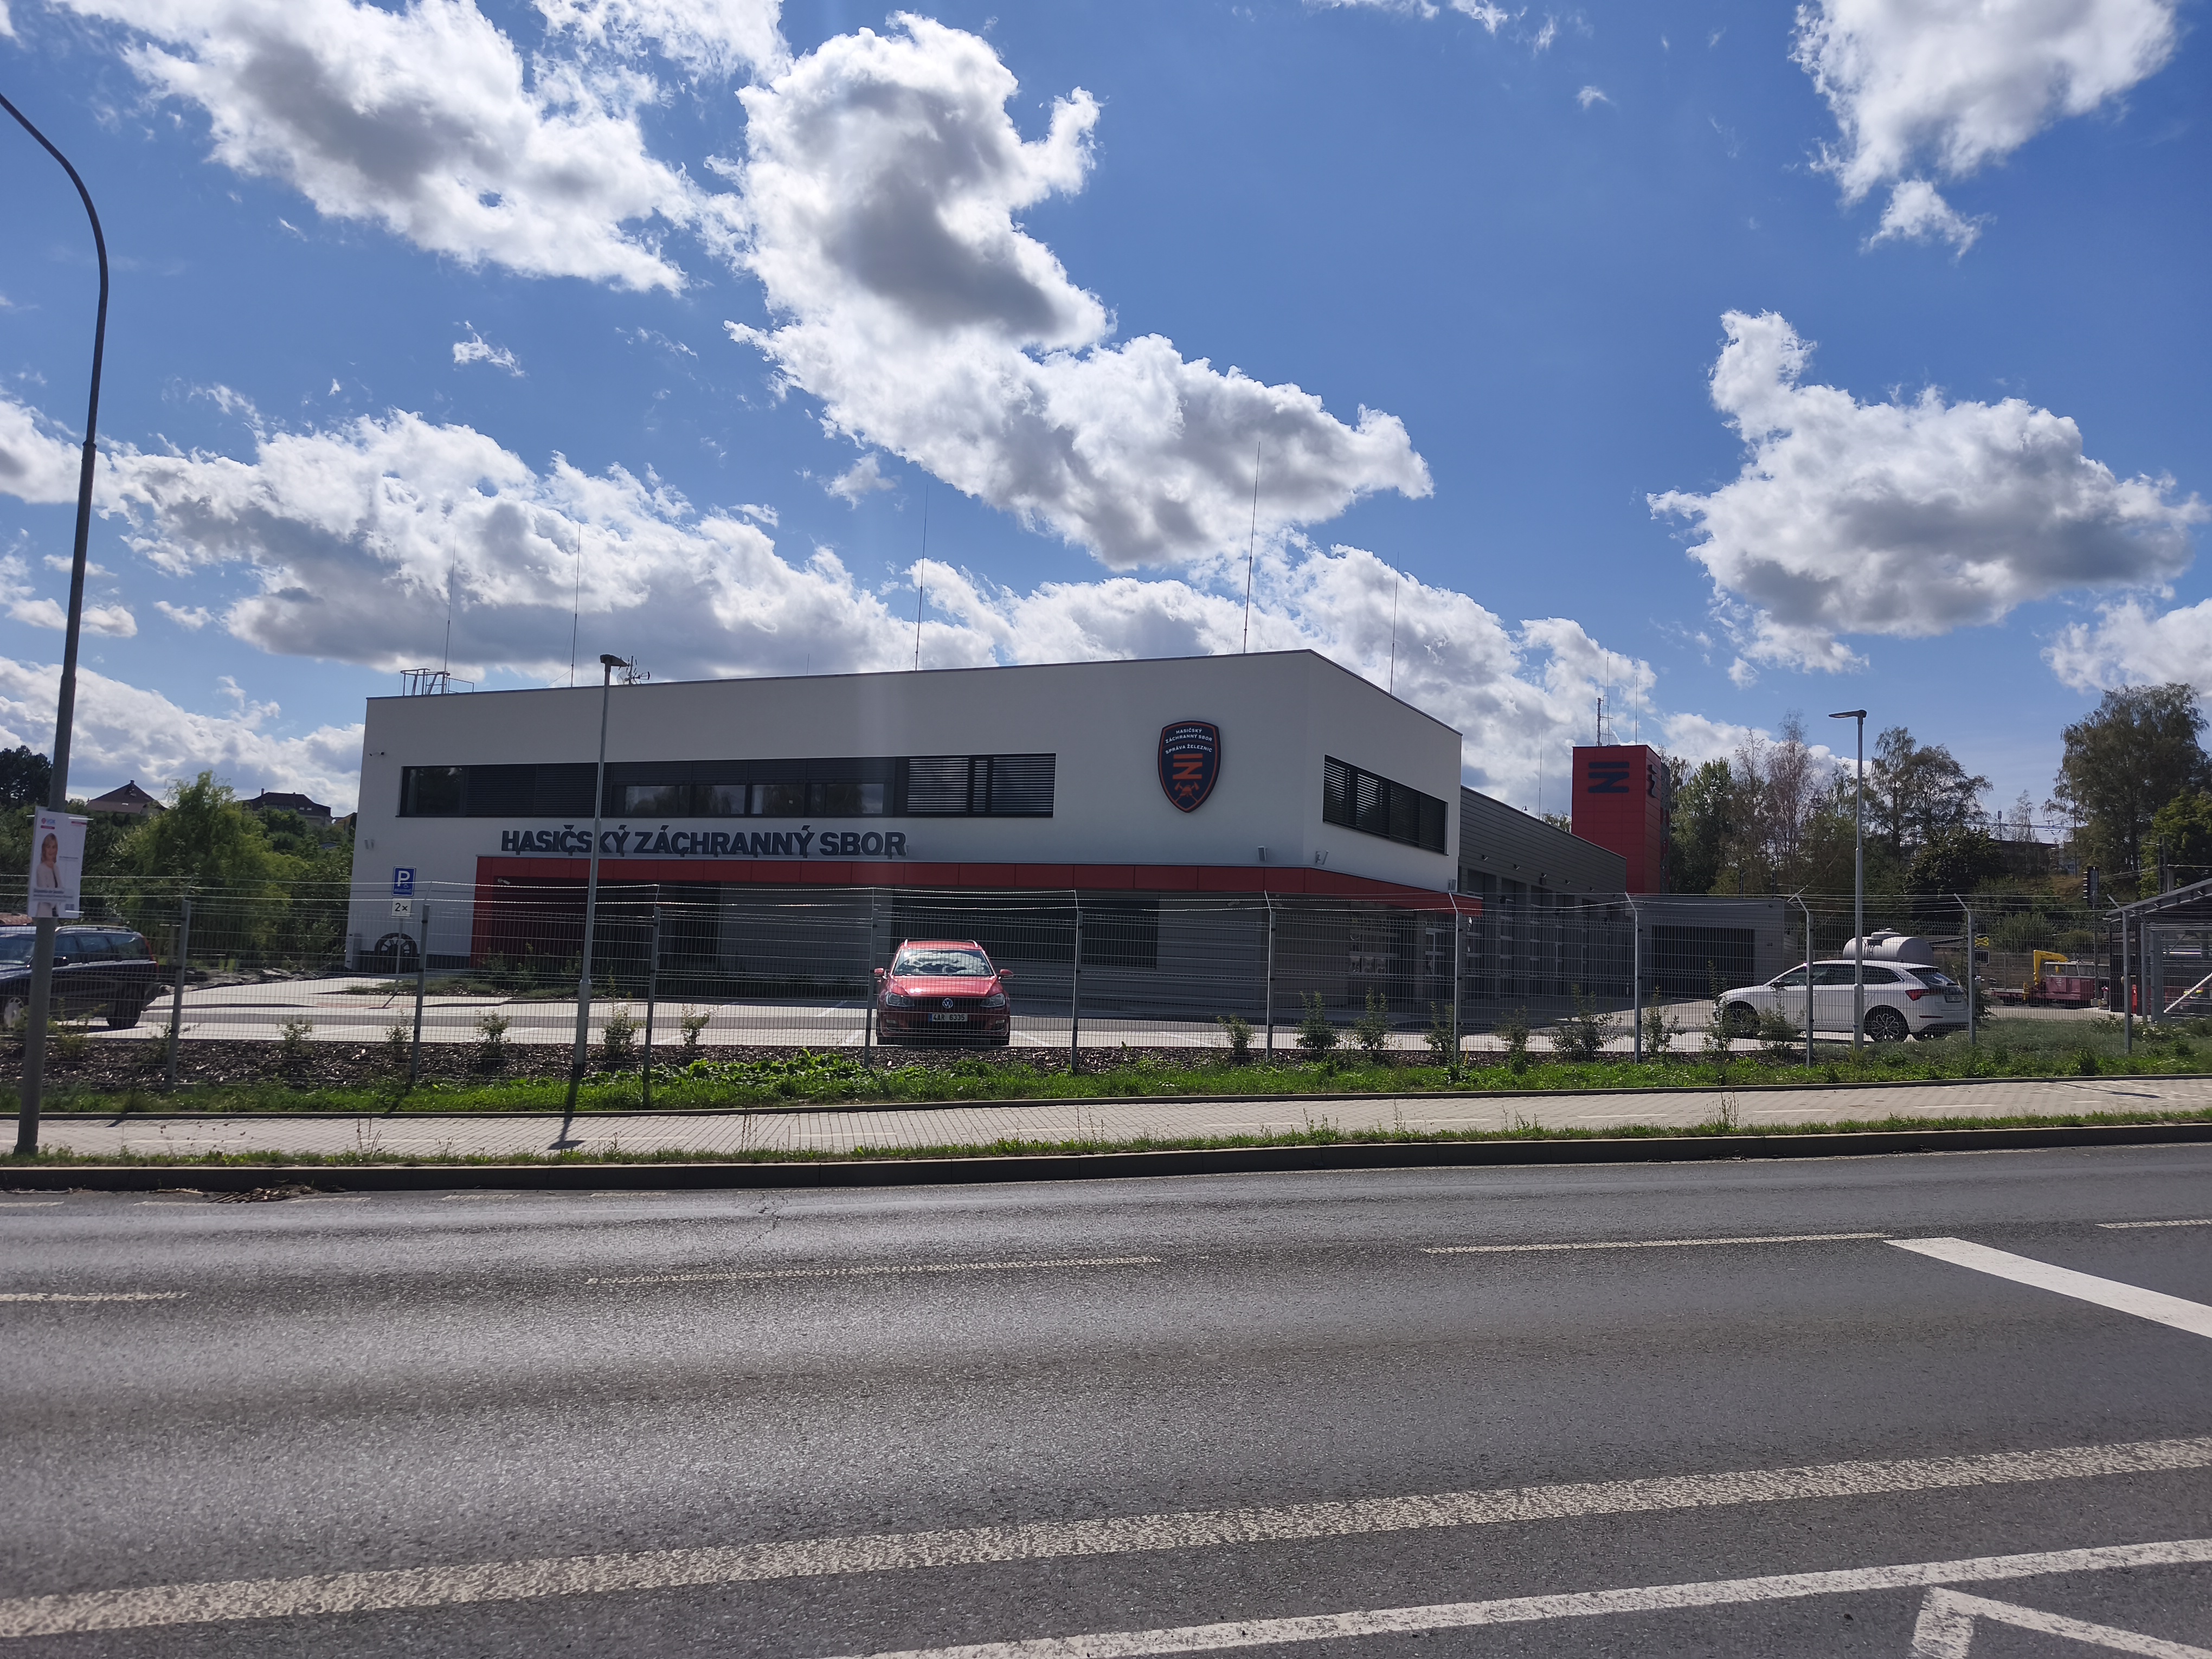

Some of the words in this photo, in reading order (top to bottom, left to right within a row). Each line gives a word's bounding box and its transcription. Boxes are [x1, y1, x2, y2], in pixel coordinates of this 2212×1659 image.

[1165, 734, 1198, 743] ZÁCHRANNÝ
[1165, 745, 1186, 754] SPRÁVA
[1187, 743, 1212, 753] ŽELEZNIC
[501, 825, 631, 853] HASIČSKÝ
[634, 825, 815, 856] ZÁCHRANNÝ
[819, 832, 907, 856] SBOR
[397, 870, 410, 886] P
